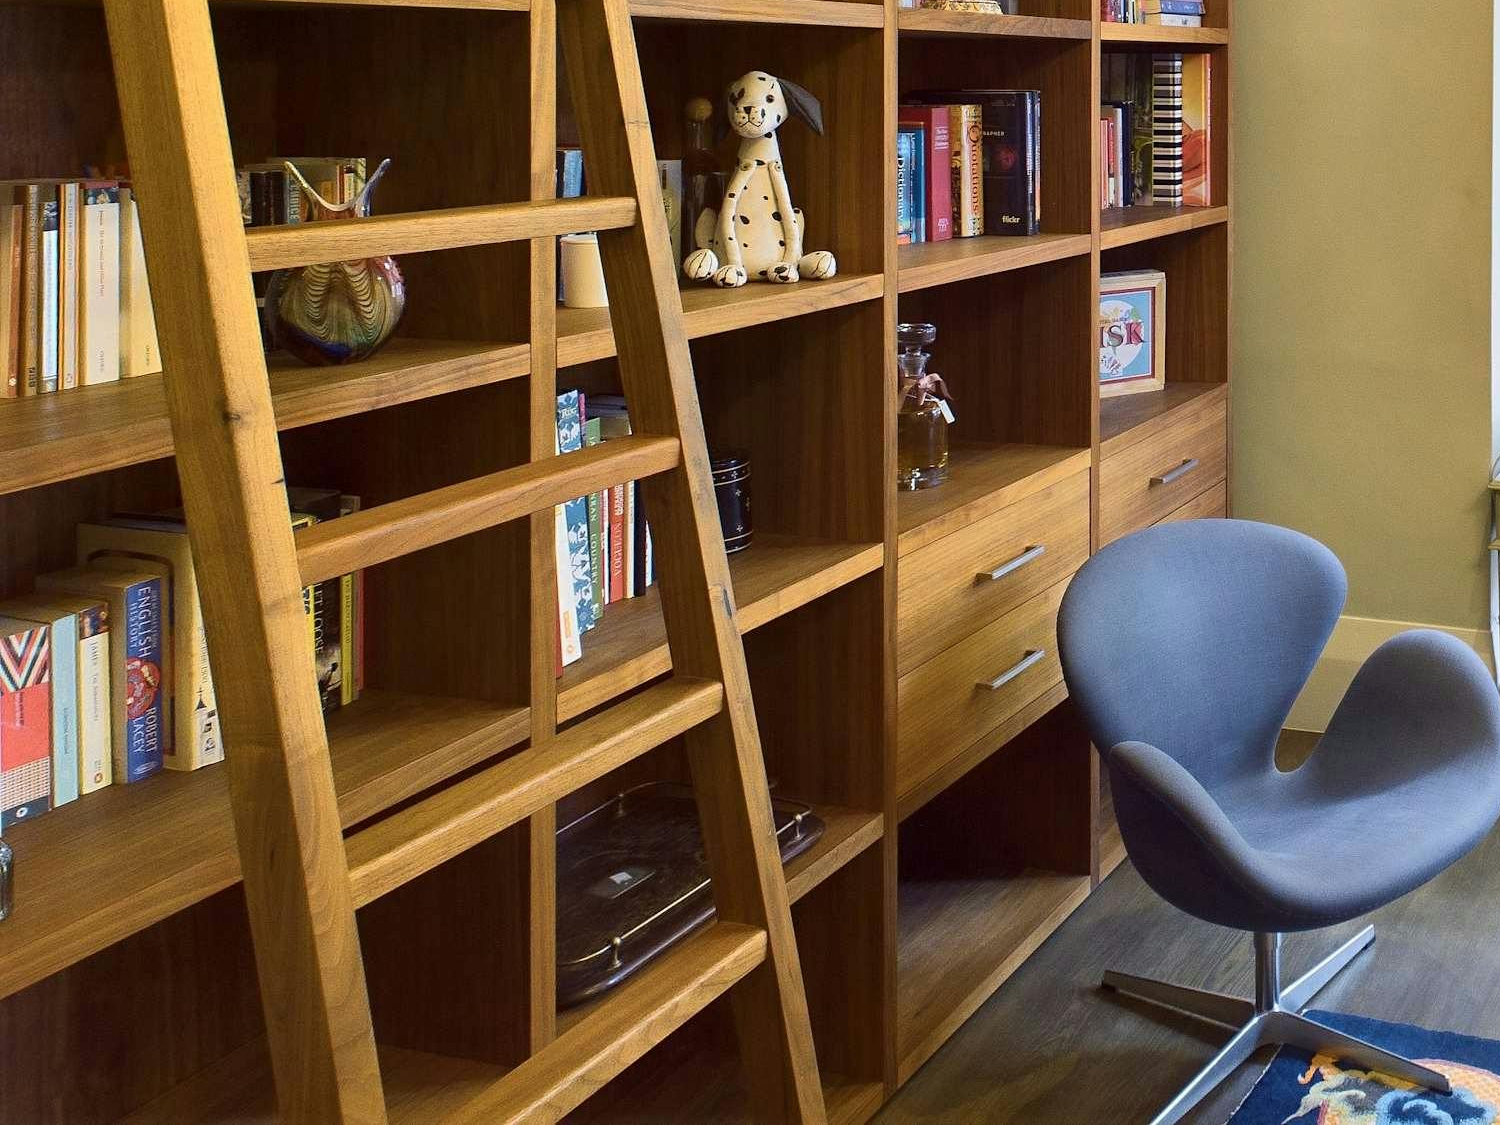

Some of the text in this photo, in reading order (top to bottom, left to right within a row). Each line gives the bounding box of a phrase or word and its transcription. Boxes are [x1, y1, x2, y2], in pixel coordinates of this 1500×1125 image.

[897, 156, 906, 221] Dictionary
[968, 124, 981, 212] Quotations
[1002, 214, 1021, 224] flickr
[1099, 321, 1145, 349] ISK
[590, 532, 598, 585] COUNTRY
[128, 602, 139, 649] HISTORY
[138, 586, 153, 658] ENGLISH
[132, 715, 146, 754] LACEY
[145, 706, 158, 753] ROBERT
